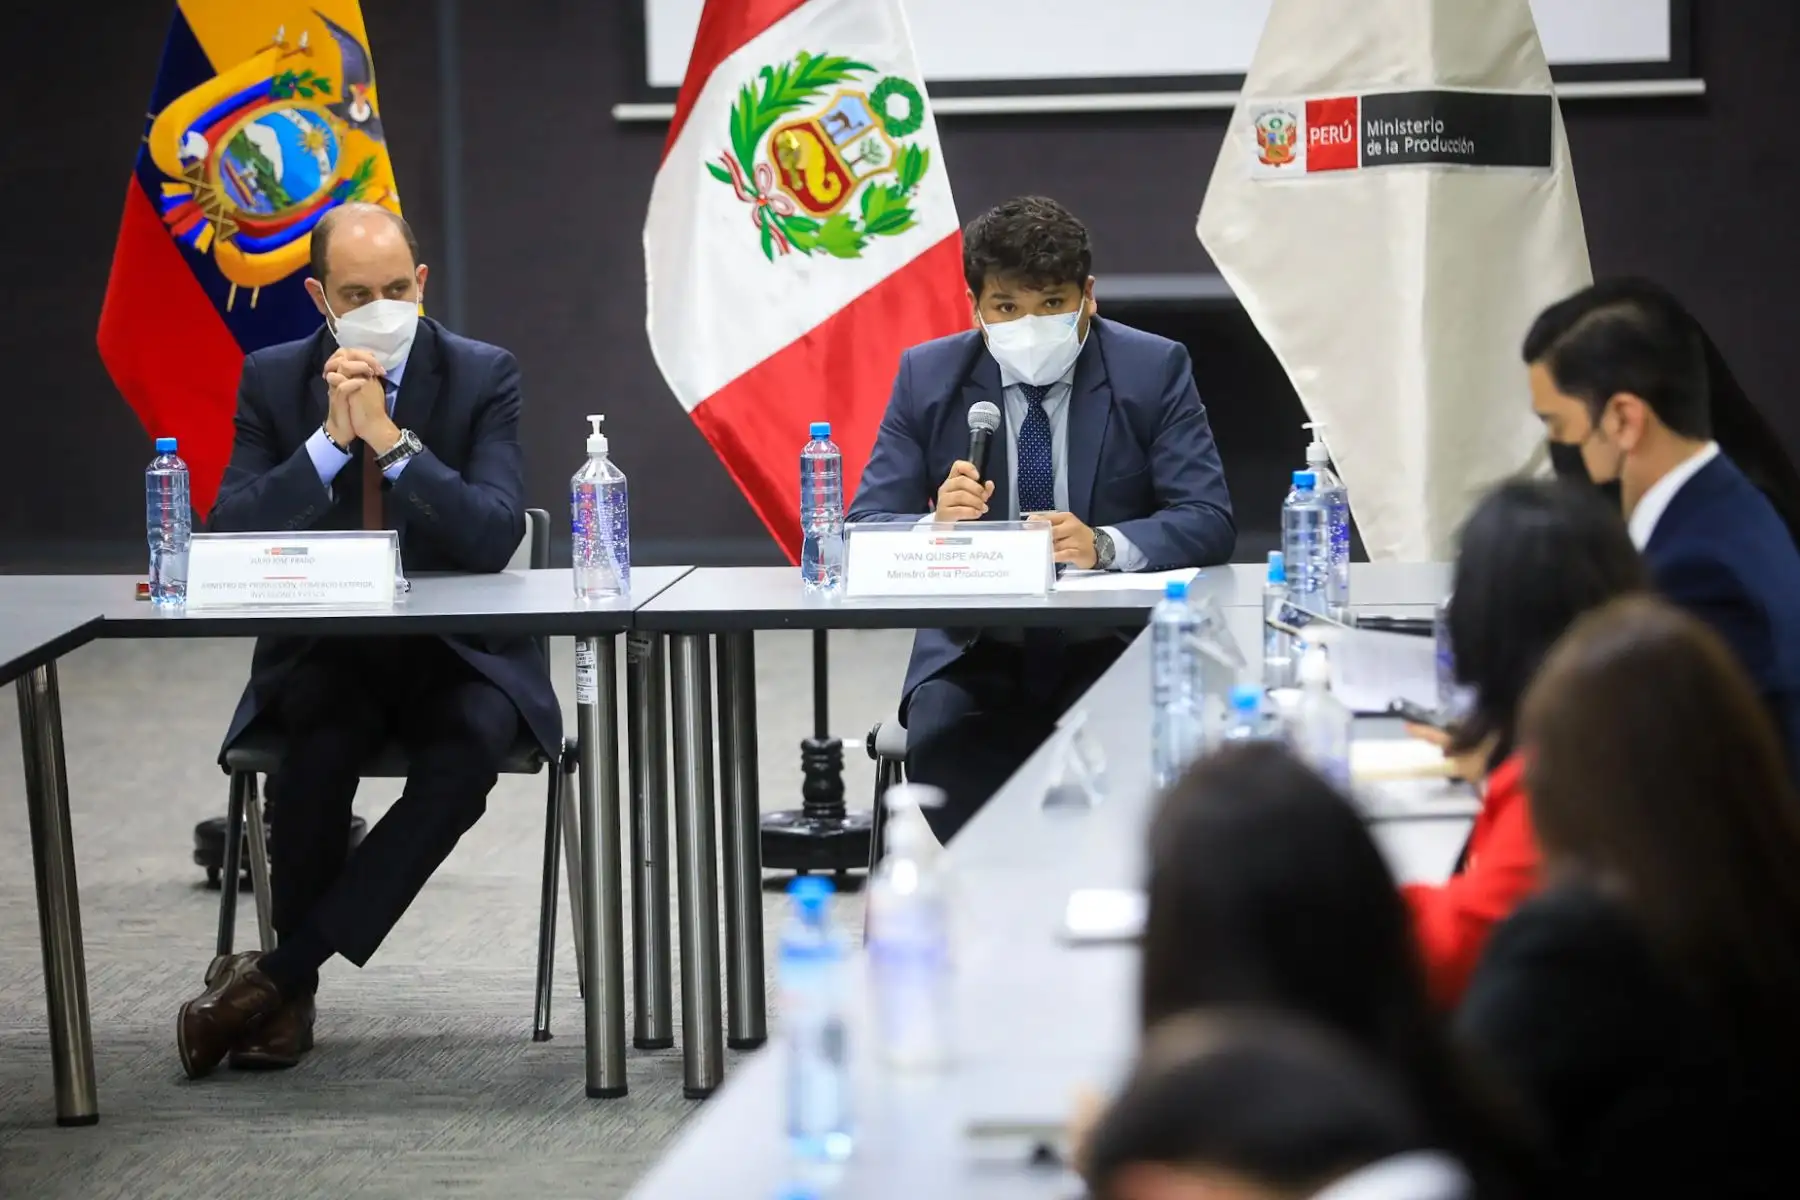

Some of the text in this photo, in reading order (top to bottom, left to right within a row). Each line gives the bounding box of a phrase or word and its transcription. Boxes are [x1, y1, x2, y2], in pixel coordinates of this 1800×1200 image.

[1309, 120, 1353, 145] PERÚ
[1366, 117, 1445, 137] Ministerio
[1366, 136, 1475, 157] de la Producción
[894, 551, 1004, 561] YVAN QUISPE APAZA
[887, 570, 926, 579] Ministro
[927, 570, 940, 578] de
[942, 570, 952, 578] la
